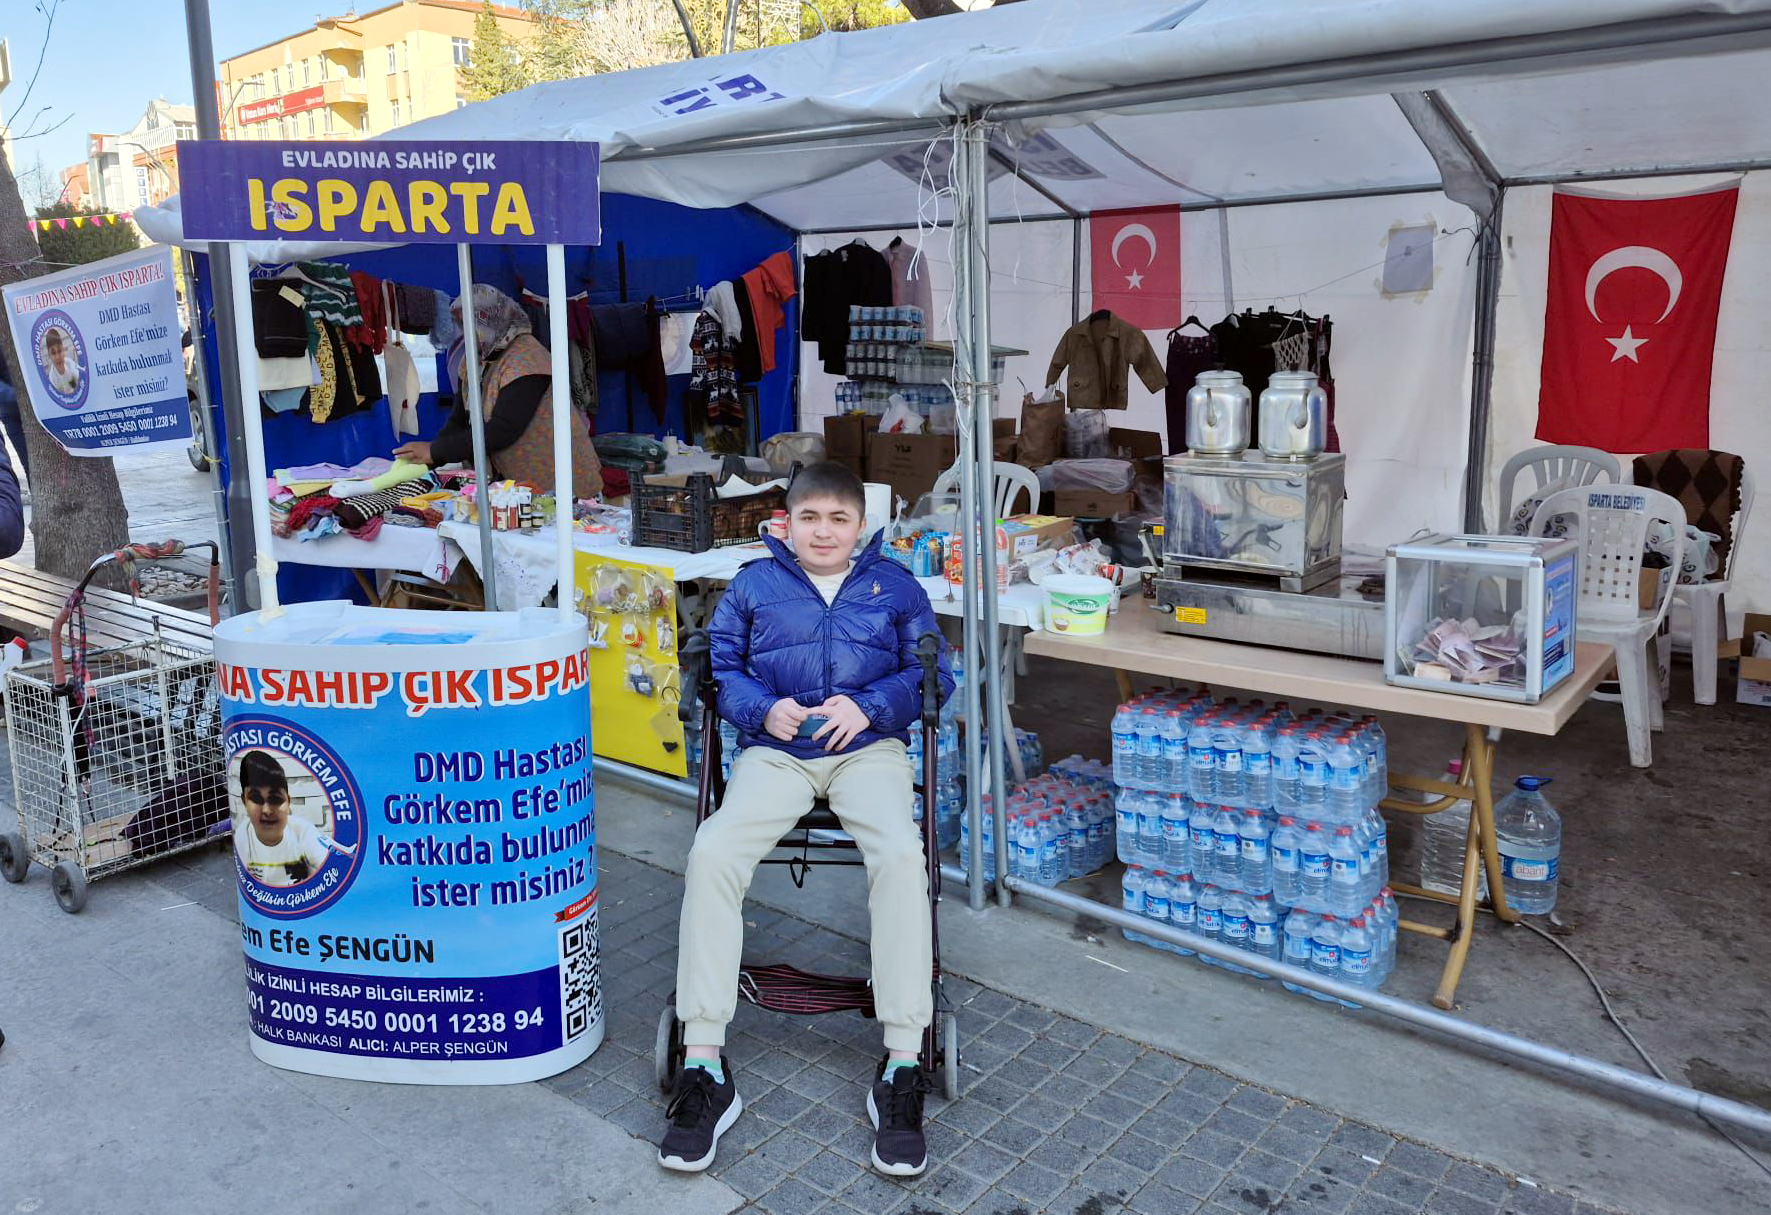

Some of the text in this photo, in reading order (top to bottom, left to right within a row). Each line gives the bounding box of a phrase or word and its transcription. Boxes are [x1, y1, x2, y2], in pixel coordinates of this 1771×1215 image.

[282, 150, 390, 169] EVLADINA
[462, 152, 497, 174] ÇIK
[248, 178, 535, 236] ISPARTA
[16, 262, 164, 314] EVLADINA SAHİP ÇIK ISPARTA!
[99, 301, 151, 325] DMD Hastası
[95, 323, 169, 351] Görkem Efe'mize
[95, 349, 173, 377] katkıda bulunmak
[112, 384, 135, 400] ister
[63, 414, 178, 440] TR78 0001 2009 5450 0001 1238 94
[1588, 493, 1612, 509] ISPARTA
[404, 669, 478, 713] ÇIK
[413, 734, 588, 783] DMD Hastası
[267, 732, 338, 788] GÖRKEM
[330, 788, 352, 821] EFE
[384, 791, 502, 825] Görkem
[377, 834, 494, 866] katkıda
[246, 880, 286, 906] Değilsin
[285, 883, 326, 908] Görkem
[323, 866, 340, 887] Efe
[411, 845, 594, 907] ister misiniz ?
[1515, 865, 1545, 876] abant
[269, 928, 310, 956] Efe
[317, 933, 434, 964] ŞENGÜN
[267, 971, 306, 994] İZİNLİ
[310, 981, 362, 999] HESAP
[366, 984, 475, 1004] BİLGİLERİMİZ
[269, 999, 318, 1025] 2009
[325, 1007, 377, 1031] 5450
[384, 1012, 438, 1034] 0001
[448, 1012, 506, 1034] 1238
[514, 1006, 545, 1031] 94
[257, 1019, 285, 1040] HALK
[286, 1028, 342, 1048] BANKASI
[348, 1037, 389, 1052] ALICI:
[393, 1040, 440, 1054] ALPER
[444, 1039, 508, 1058] ŞENGÜN
